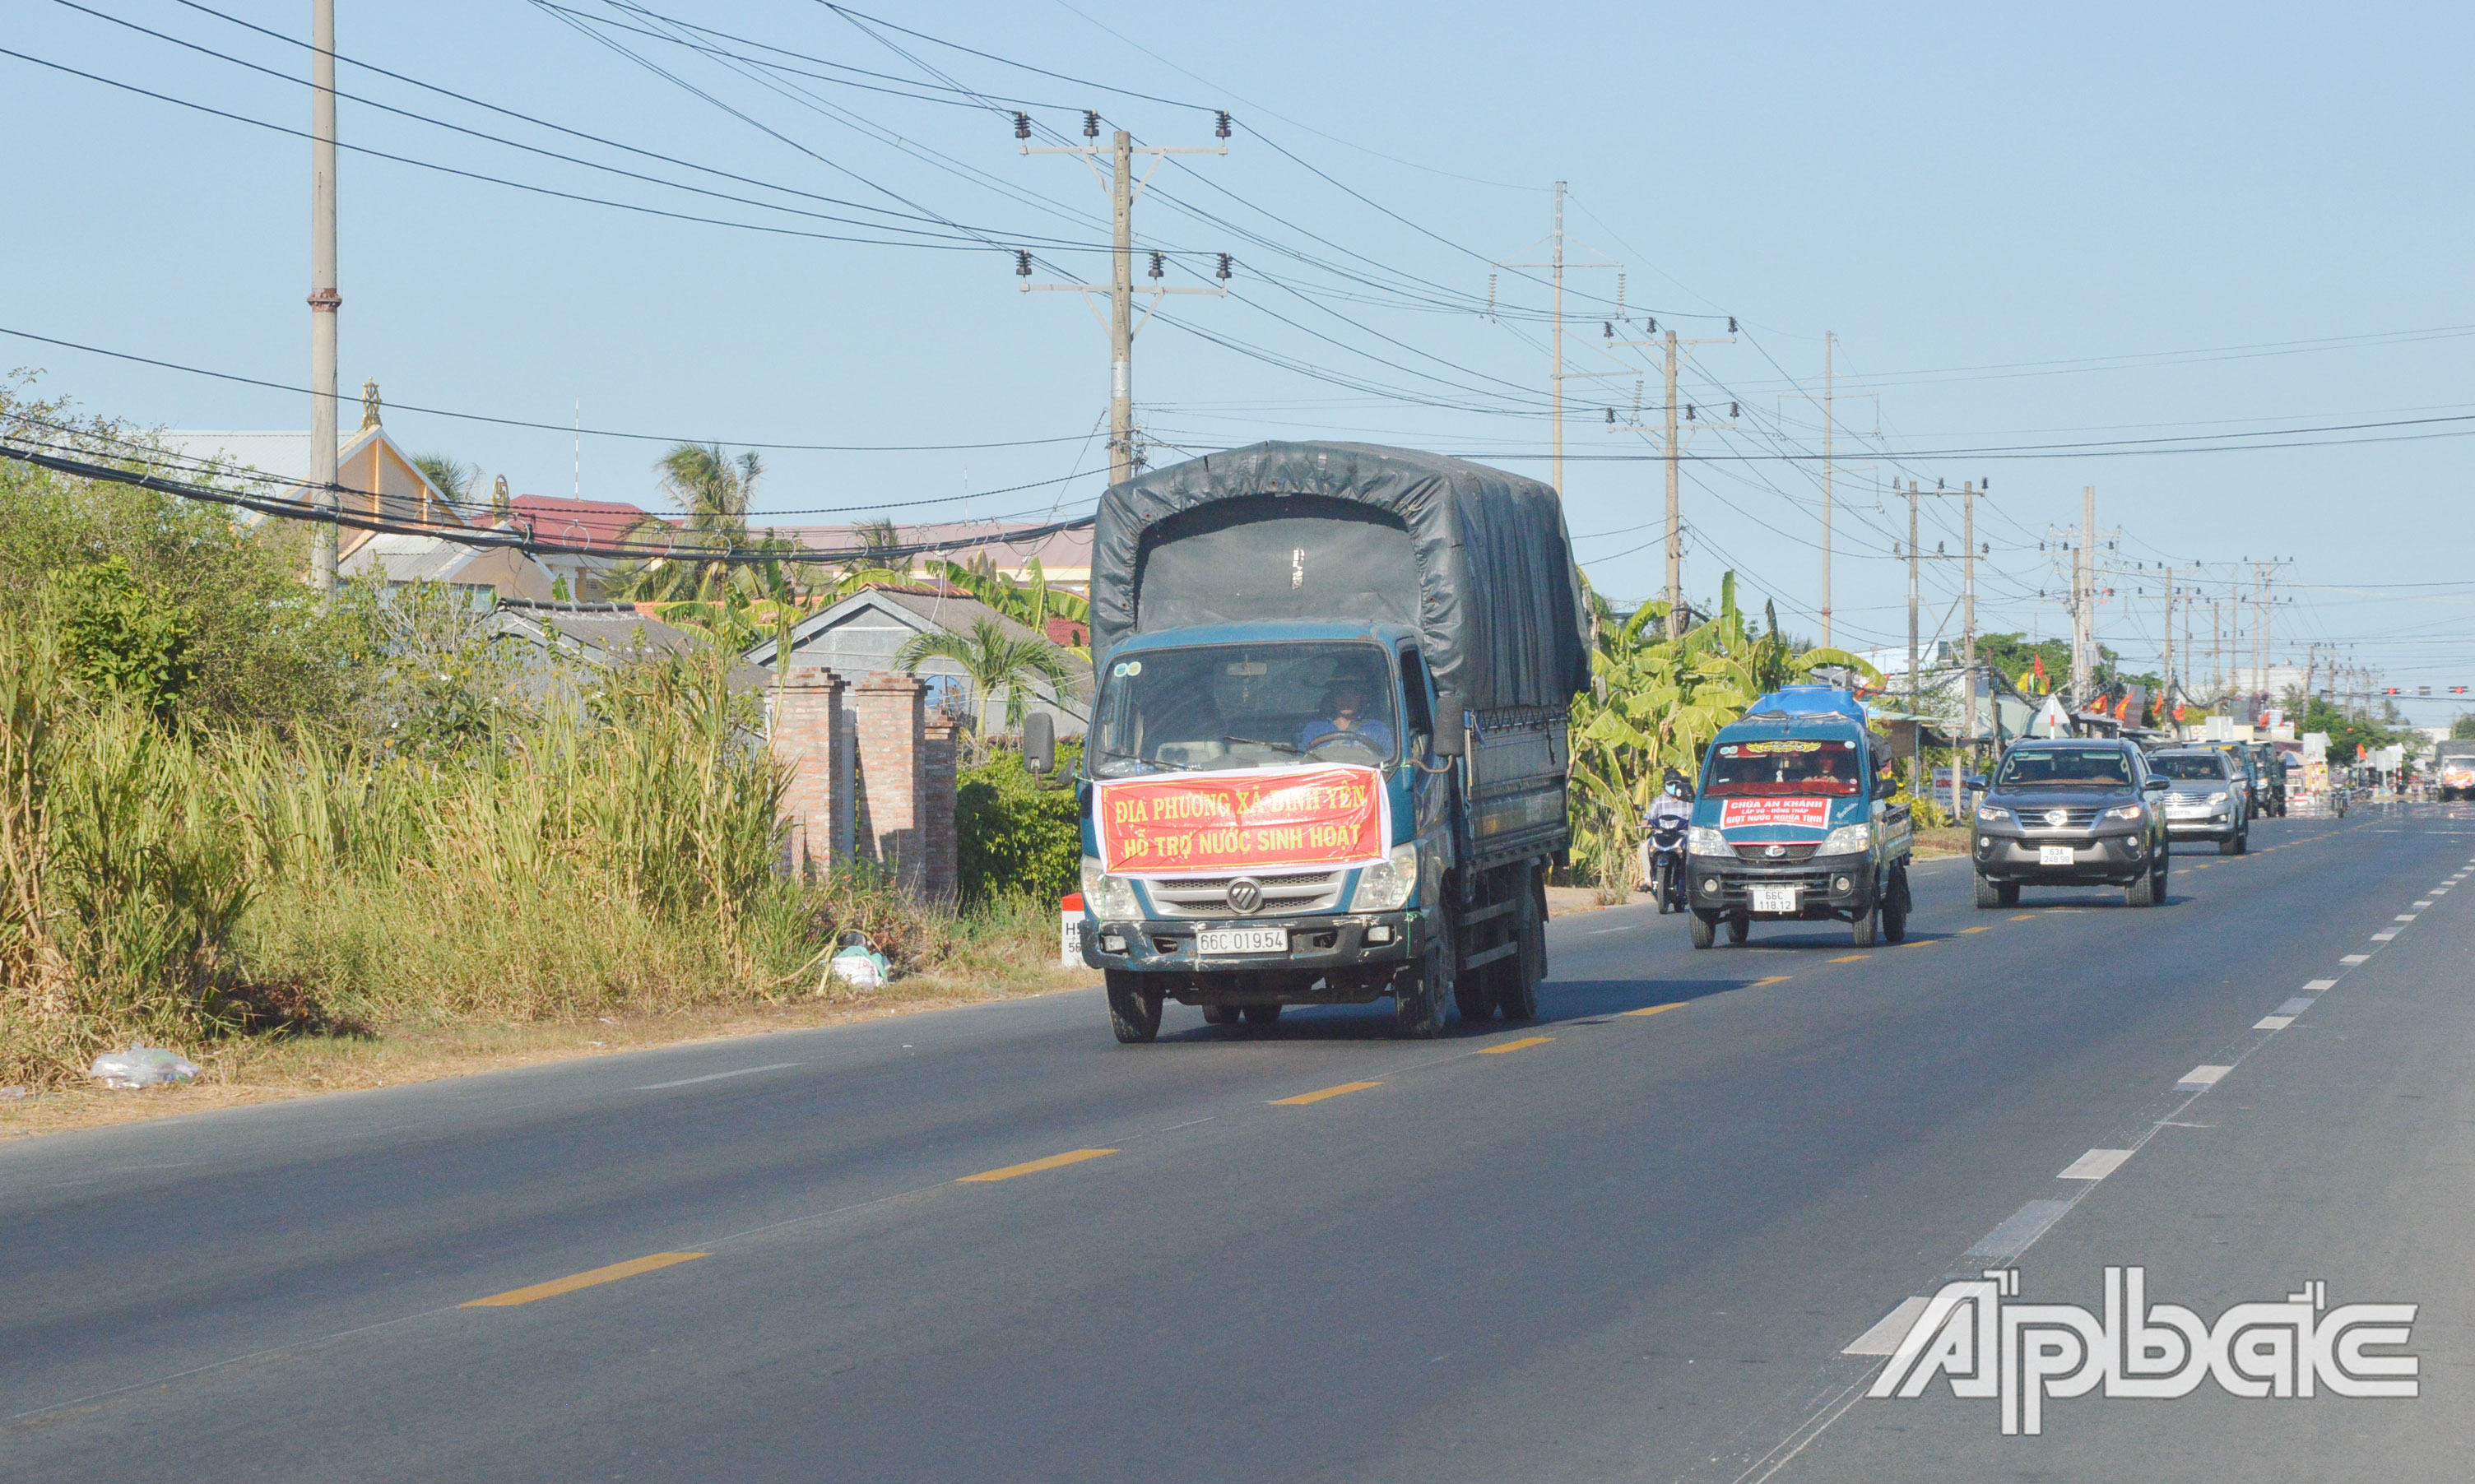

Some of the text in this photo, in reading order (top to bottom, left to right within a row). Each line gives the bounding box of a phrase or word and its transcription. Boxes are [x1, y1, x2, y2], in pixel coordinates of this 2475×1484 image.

[1115, 799, 1149, 828] ĐỊA
[1152, 791, 1232, 821] PHƯƠNG
[1326, 780, 1367, 809] YÊN
[1731, 800, 1761, 809] CHÙA
[1783, 799, 1823, 809] KHÁNH
[1726, 815, 1746, 825] GIỌT
[1747, 814, 1771, 823] NƯỚC
[1773, 814, 1800, 822] NGHĨA
[1124, 823, 1362, 860] HỖ TRỢ NƯỚC SINH HOẠT
[1765, 891, 1784, 900] 66C
